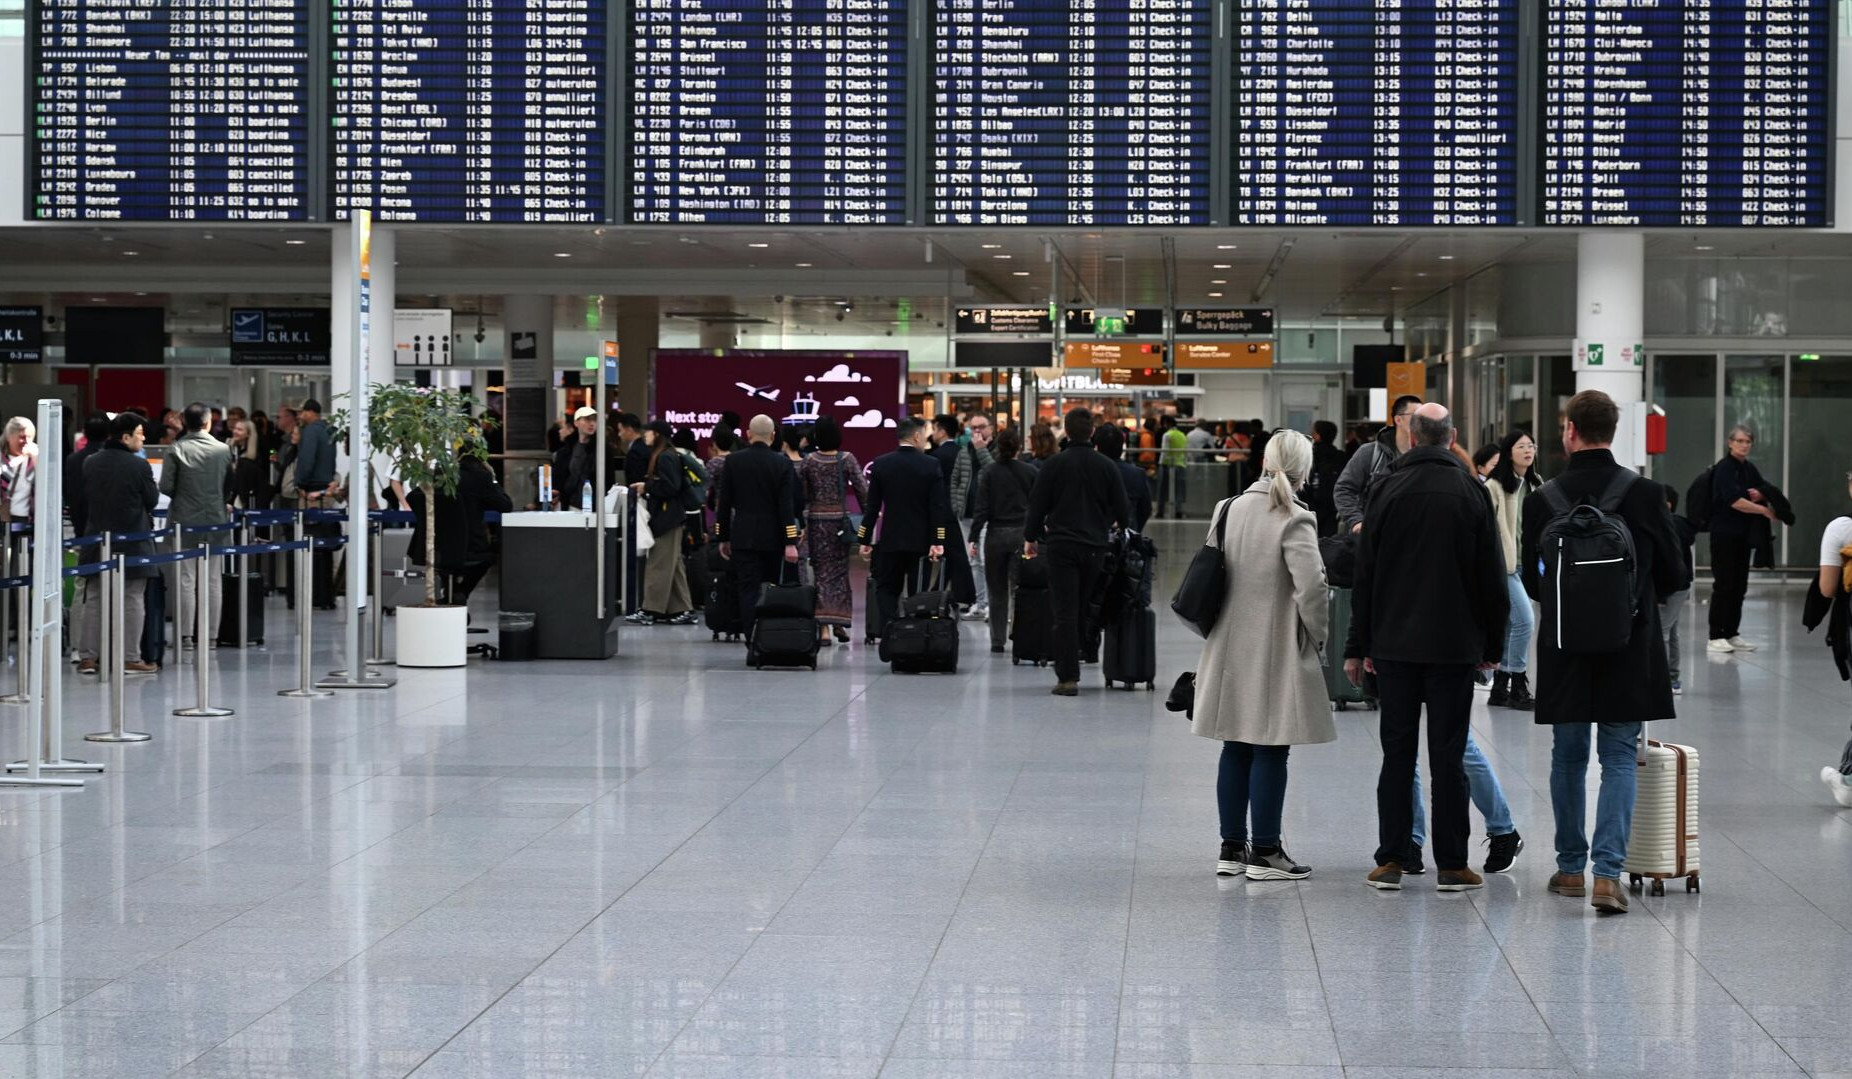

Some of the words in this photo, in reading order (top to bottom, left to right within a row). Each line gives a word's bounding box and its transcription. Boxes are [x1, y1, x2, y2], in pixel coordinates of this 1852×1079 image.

[382, 11, 427, 21] Marseille
[468, 12, 492, 21] 11:15
[546, 12, 587, 21] boarding
[982, 13, 1003, 22] Prag
[1070, 13, 1095, 22] 12:05
[1150, 13, 1192, 22] Check-in
[1287, 12, 1312, 21] Delhi
[1456, 12, 1498, 21] Check-in
[1595, 11, 1622, 20] Malta
[1766, 11, 1809, 21] Check-in
[86, 24, 125, 33] Shanghai
[170, 24, 195, 33] 22:20
[249, 24, 294, 33] Lufthansa
[1070, 26, 1095, 35] 12:10
[1150, 26, 1191, 35] Check-in
[680, 39, 696, 48] San
[701, 39, 747, 48] Francisco
[846, 40, 888, 49] Check-in
[1287, 39, 1333, 48] Charlotte
[1375, 39, 1400, 48] 13:10
[1456, 39, 1498, 48] Check-in
[468, 52, 492, 61] 11:20
[546, 52, 587, 62] boarding
[1766, 52, 1808, 62] Check-in
[86, 64, 116, 73] Lisbon
[170, 64, 195, 73] 06:05
[248, 64, 294, 73] Lufthansa
[680, 66, 725, 75] Stuttgart
[767, 66, 791, 75] 11:50
[846, 67, 887, 76] Check-in
[1766, 66, 1808, 75] Check-in
[681, 79, 716, 88] Toronto
[767, 80, 791, 89] 11:50
[846, 80, 887, 89] Check-in
[1594, 79, 1646, 88] Kopenhagen
[1765, 79, 1807, 89] Check-in
[86, 90, 121, 99] Billund
[171, 90, 195, 99] 10:55
[248, 91, 294, 100] Lufthansa
[381, 91, 417, 101] Dresden
[467, 92, 492, 101] 11:25
[680, 92, 716, 102] Venedig
[766, 93, 791, 102] 11:50
[846, 93, 887, 103] Check-in
[982, 93, 1018, 102] Houston
[1069, 93, 1094, 103] 12:20
[1149, 93, 1191, 103] Check-in
[86, 116, 116, 125] Berlin
[248, 117, 289, 126] boarding
[981, 120, 1013, 129] Bilbao
[1069, 120, 1094, 129] 12:25
[1149, 120, 1191, 130] Check-in
[1286, 120, 1328, 129] Lissabon
[1374, 120, 1399, 129] 13:35
[1455, 120, 1497, 129] Check-in
[1593, 120, 1625, 129] Madrid
[1765, 120, 1807, 130] Check-in
[86, 129, 106, 139] Nice
[248, 130, 289, 140] boarding
[467, 145, 491, 154] 11:30
[545, 145, 586, 155] Check-in
[679, 146, 725, 155] Edinburgh
[845, 147, 886, 156] Check-in
[1285, 147, 1317, 156] Berlin
[1455, 147, 1497, 156] Check-in
[171, 156, 195, 166] 11:05
[248, 157, 293, 166] cancelled
[981, 160, 1022, 170] Singapur
[1069, 161, 1094, 170] 12:30
[1148, 161, 1190, 170] Check-in
[1593, 160, 1640, 170] Paderborn
[1764, 161, 1806, 170] Check-in
[466, 171, 491, 181] 11:30
[545, 172, 585, 181] Check-in
[845, 174, 886, 183] Check-in
[1592, 174, 1618, 183] Split
[381, 184, 406, 193] Posen
[466, 185, 491, 194] 11:35
[545, 185, 585, 195] Check-in
[981, 201, 1027, 210] Barcelona
[1148, 201, 1190, 210] Check-in
[85, 209, 121, 218] Cologne
[170, 209, 195, 218] 11:10
[248, 210, 288, 219] boarding
[679, 212, 705, 222] Athen
[765, 213, 790, 222] 12:05
[845, 214, 886, 223] Check-in
[1454, 215, 1496, 224] Check-in
[1197, 311, 1245, 320] Sperrgepäck
[1197, 321, 1217, 330] Bulky
[1219, 321, 1253, 330] Baggage
[17, 329, 24, 341] L
[267, 331, 277, 343] G,
[279, 331, 289, 343] H,
[292, 331, 302, 343] K,
[304, 332, 310, 342] L
[665, 411, 696, 423] Next
